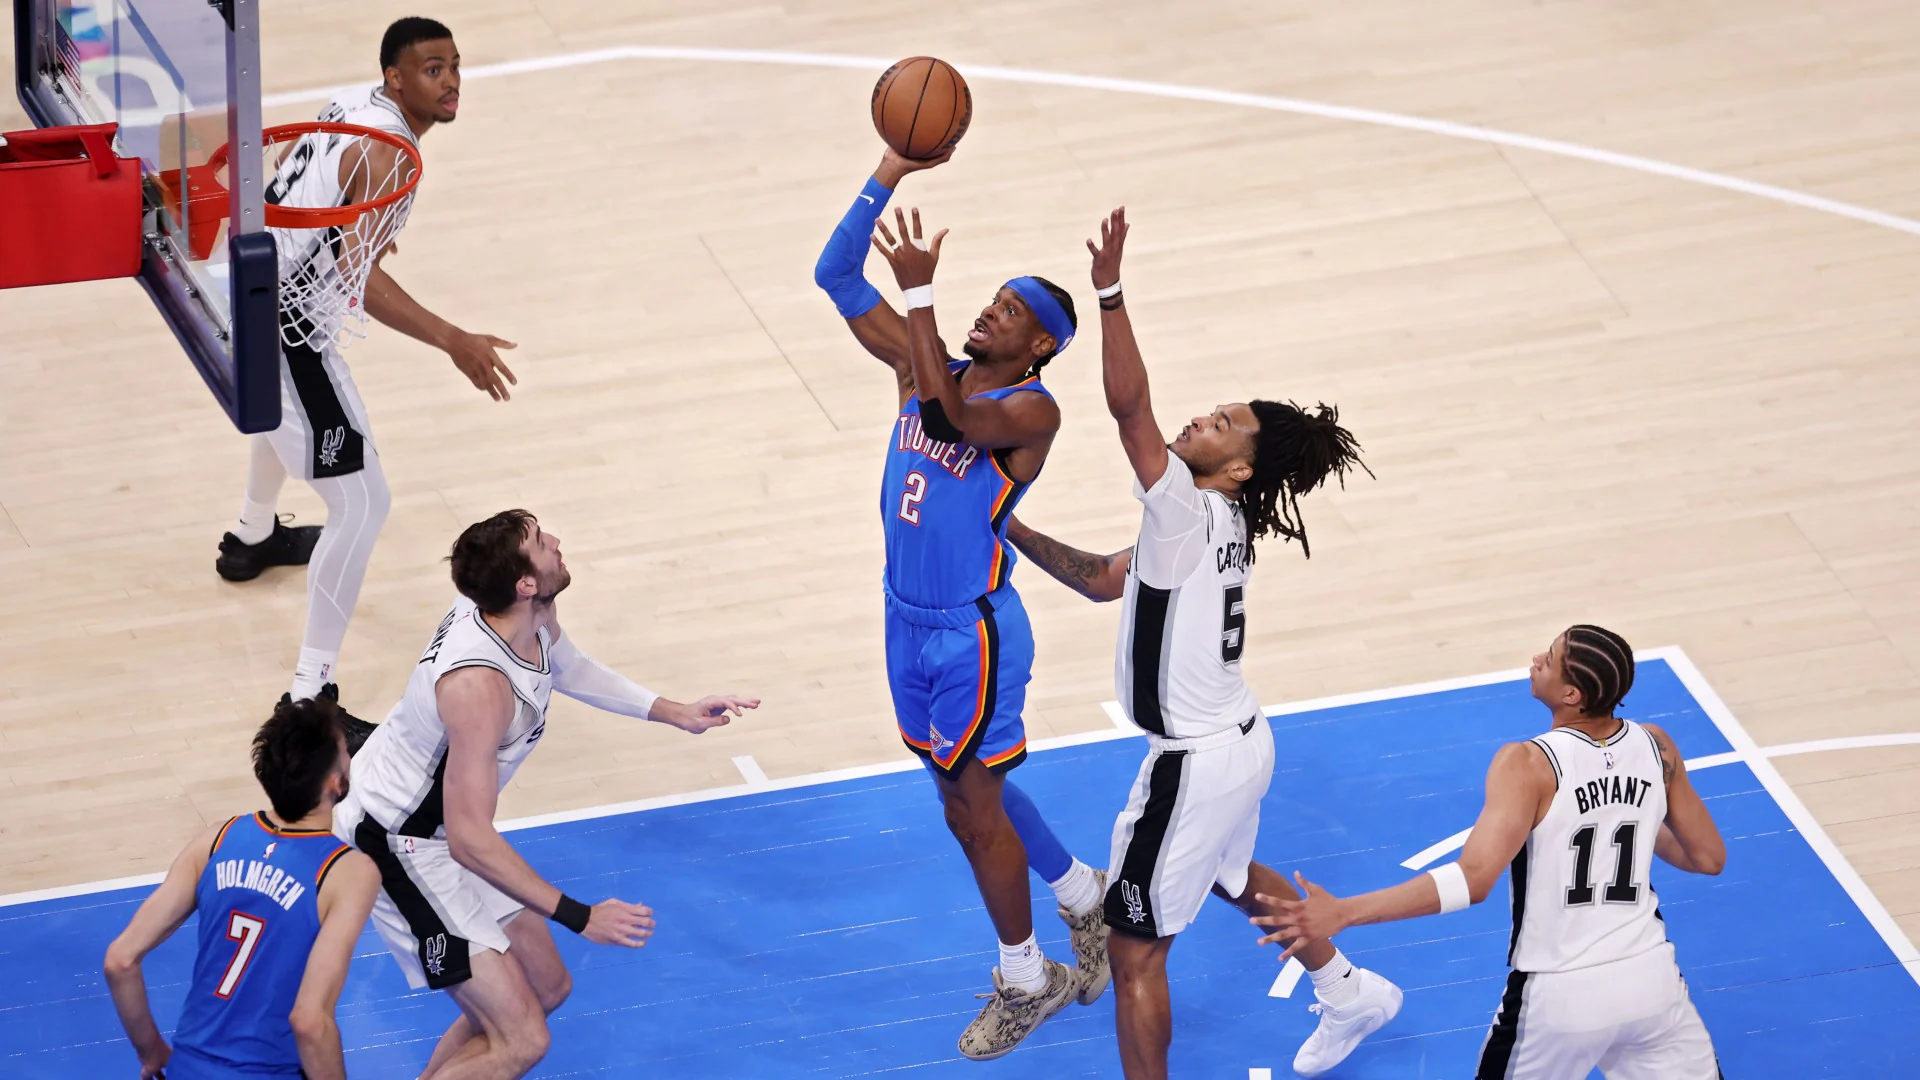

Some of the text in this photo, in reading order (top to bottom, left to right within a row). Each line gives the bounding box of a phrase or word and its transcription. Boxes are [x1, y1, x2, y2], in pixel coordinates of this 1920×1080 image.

[898, 470, 928, 527] 2
[1220, 581, 1246, 667] 5
[1574, 775, 1652, 815] BRYANT
[215, 858, 306, 911] HOLMGREN
[1564, 820, 1642, 909] 11
[213, 909, 267, 1001] 7
